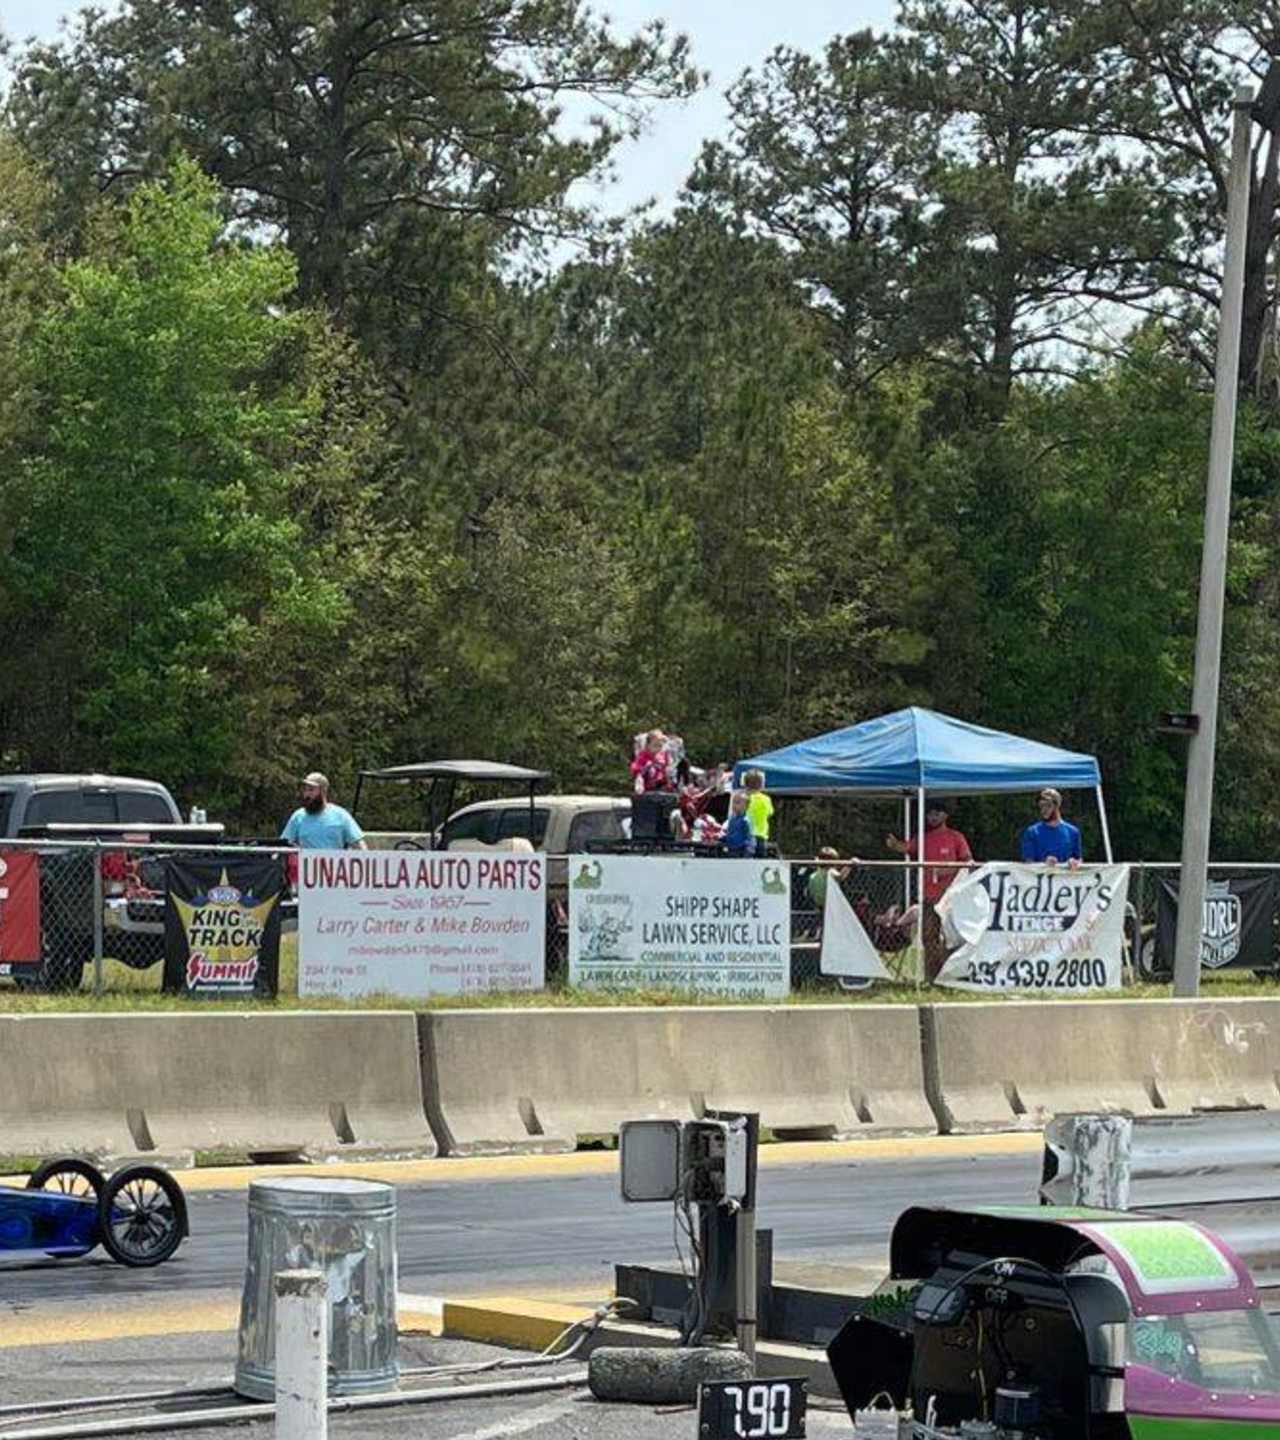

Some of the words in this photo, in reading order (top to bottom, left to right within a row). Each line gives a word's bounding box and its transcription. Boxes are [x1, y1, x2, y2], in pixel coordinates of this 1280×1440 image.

[303, 857, 411, 890] UNADILLA
[414, 858, 472, 890] AUTO
[477, 858, 542, 891] PARTS
[665, 895, 709, 918] SHIPP
[713, 897, 760, 919] SHAPE
[978, 871, 1112, 931] Hadley's
[192, 909, 241, 927] KING
[316, 916, 359, 937] Larry
[362, 916, 409, 934] Carter
[414, 916, 426, 935] &
[431, 916, 467, 934] Mike
[471, 916, 531, 935] Bowden
[1013, 916, 1065, 931] FENCE
[189, 928, 262, 948] TRACK
[642, 923, 687, 945] LAWN
[690, 923, 754, 946] SERVICE,
[756, 923, 782, 945] LLC
[640, 951, 702, 962] COMMERCIAL
[704, 951, 726, 962] AND
[727, 951, 783, 962] RESIDENTIAL
[647, 970, 721, 983] LANDSCAPING
[726, 970, 784, 983] IRRIGATION
